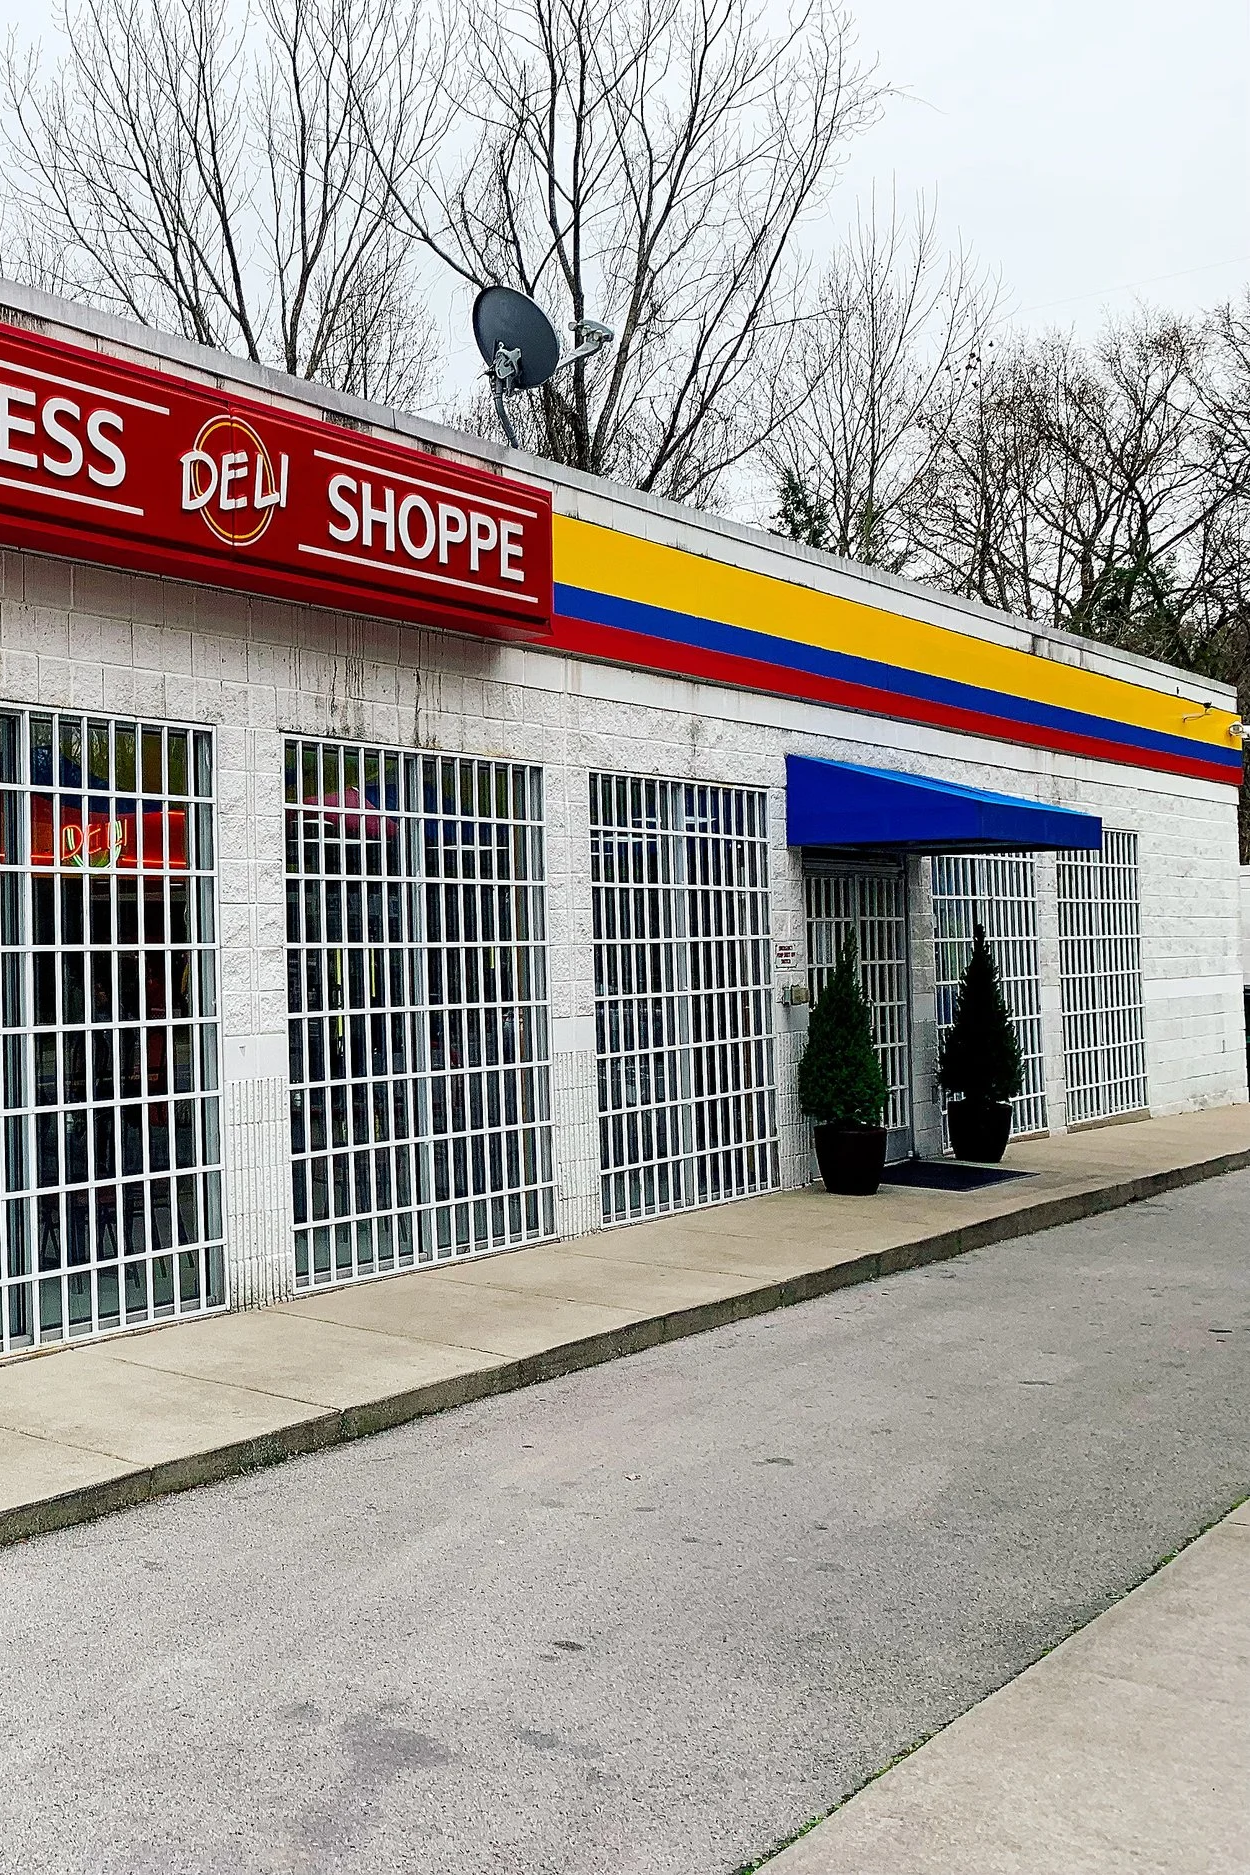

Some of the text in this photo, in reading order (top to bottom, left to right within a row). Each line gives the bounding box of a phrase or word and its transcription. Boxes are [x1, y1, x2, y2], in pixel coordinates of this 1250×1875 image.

[179, 449, 289, 511] DELI
[327, 473, 525, 582] SHOPPE
[61, 818, 128, 861] DELI
